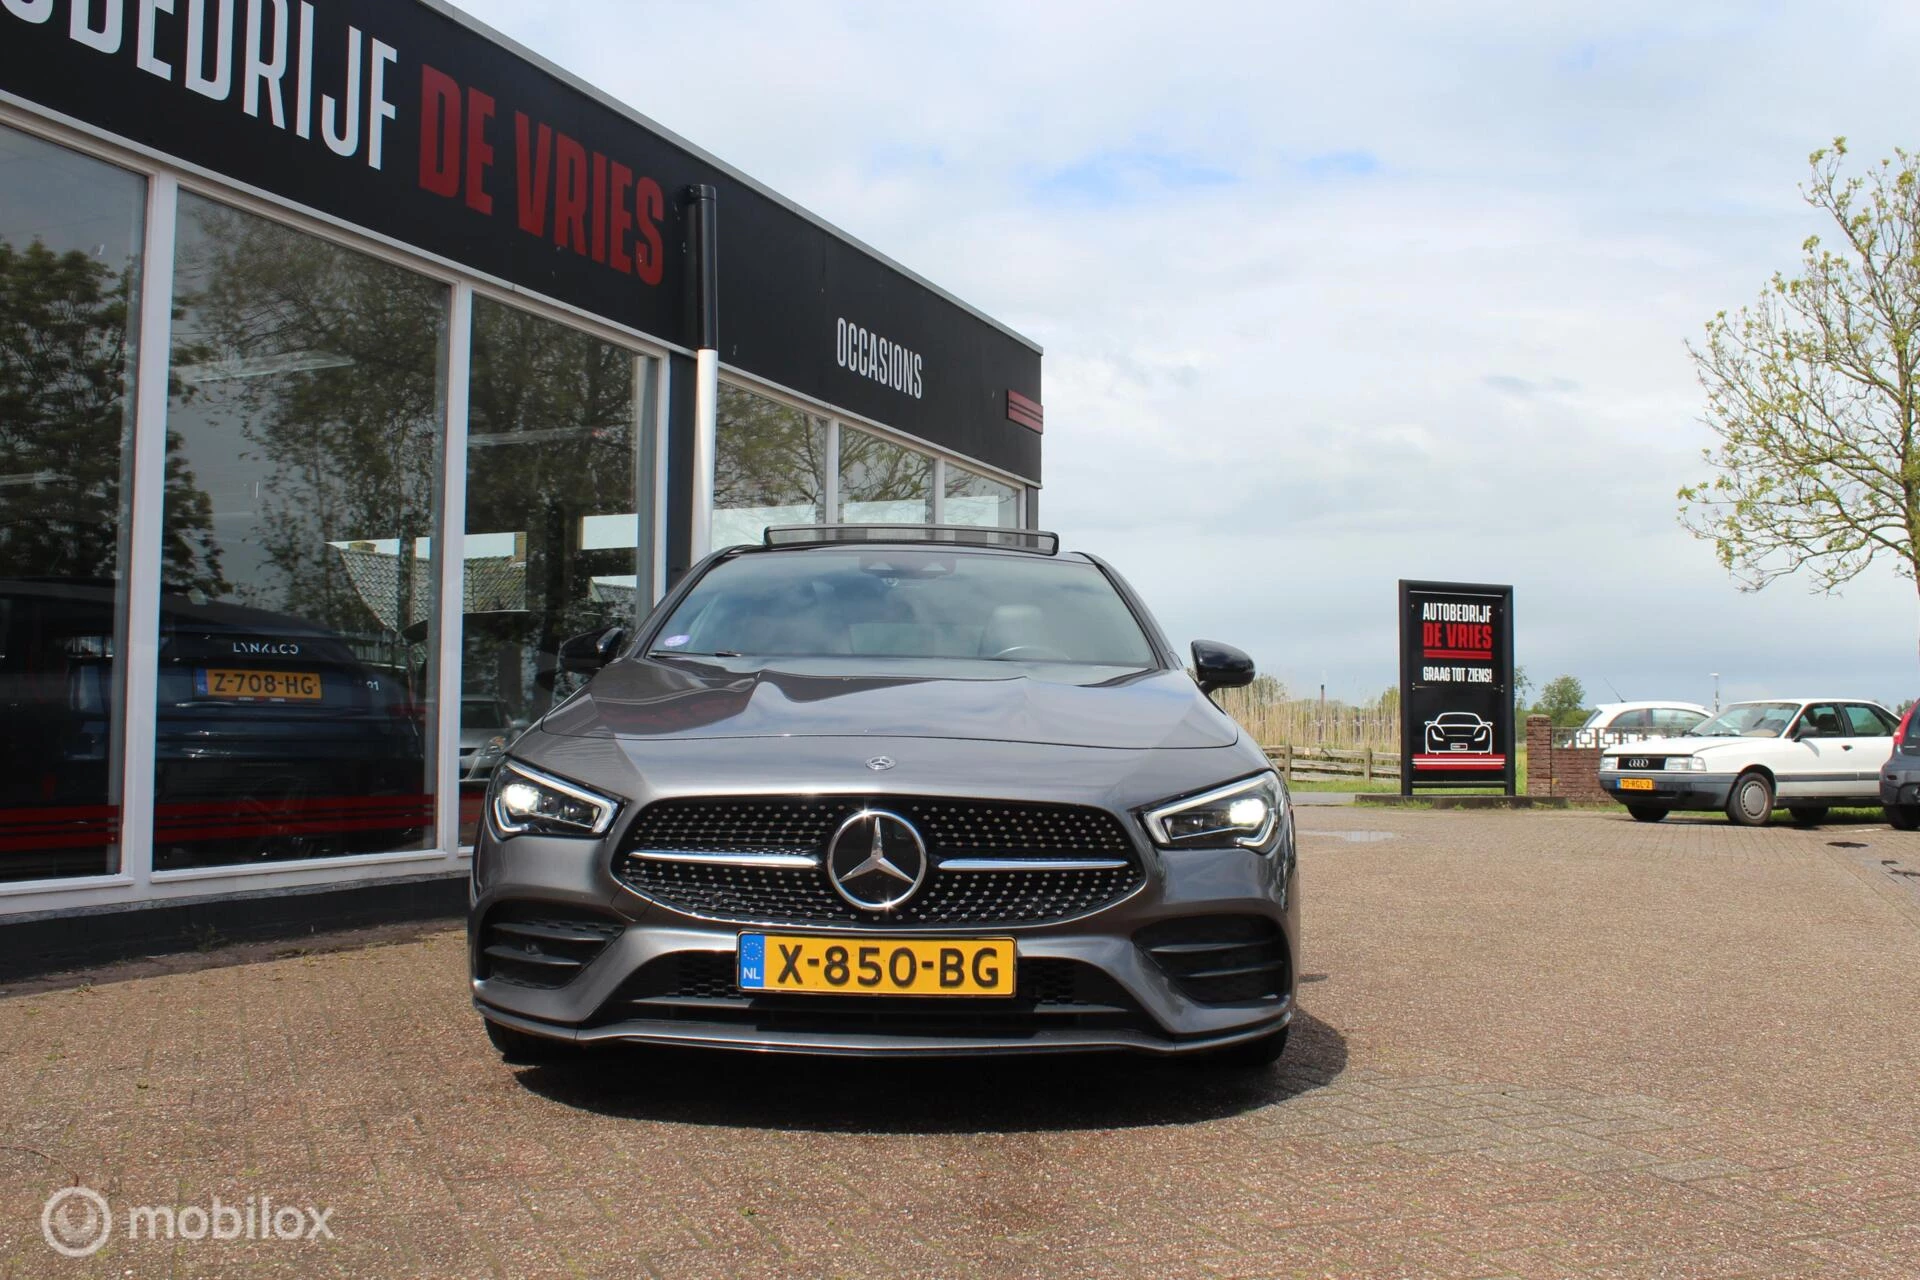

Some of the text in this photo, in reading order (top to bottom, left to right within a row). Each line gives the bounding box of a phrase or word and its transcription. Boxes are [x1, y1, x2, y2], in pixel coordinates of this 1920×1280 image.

[419, 63, 495, 216] DE
[515, 110, 665, 286] VRIES
[837, 317, 922, 399] OCCASIONS
[1422, 602, 1492, 623] AUTOBEDRIJF
[1423, 622, 1493, 649] DE VRIES
[214, 673, 314, 695] Z-708-HG
[1423, 666, 1493, 683] GRAAG TOT ZIENS!
[743, 944, 999, 989] NL X-850-BG
